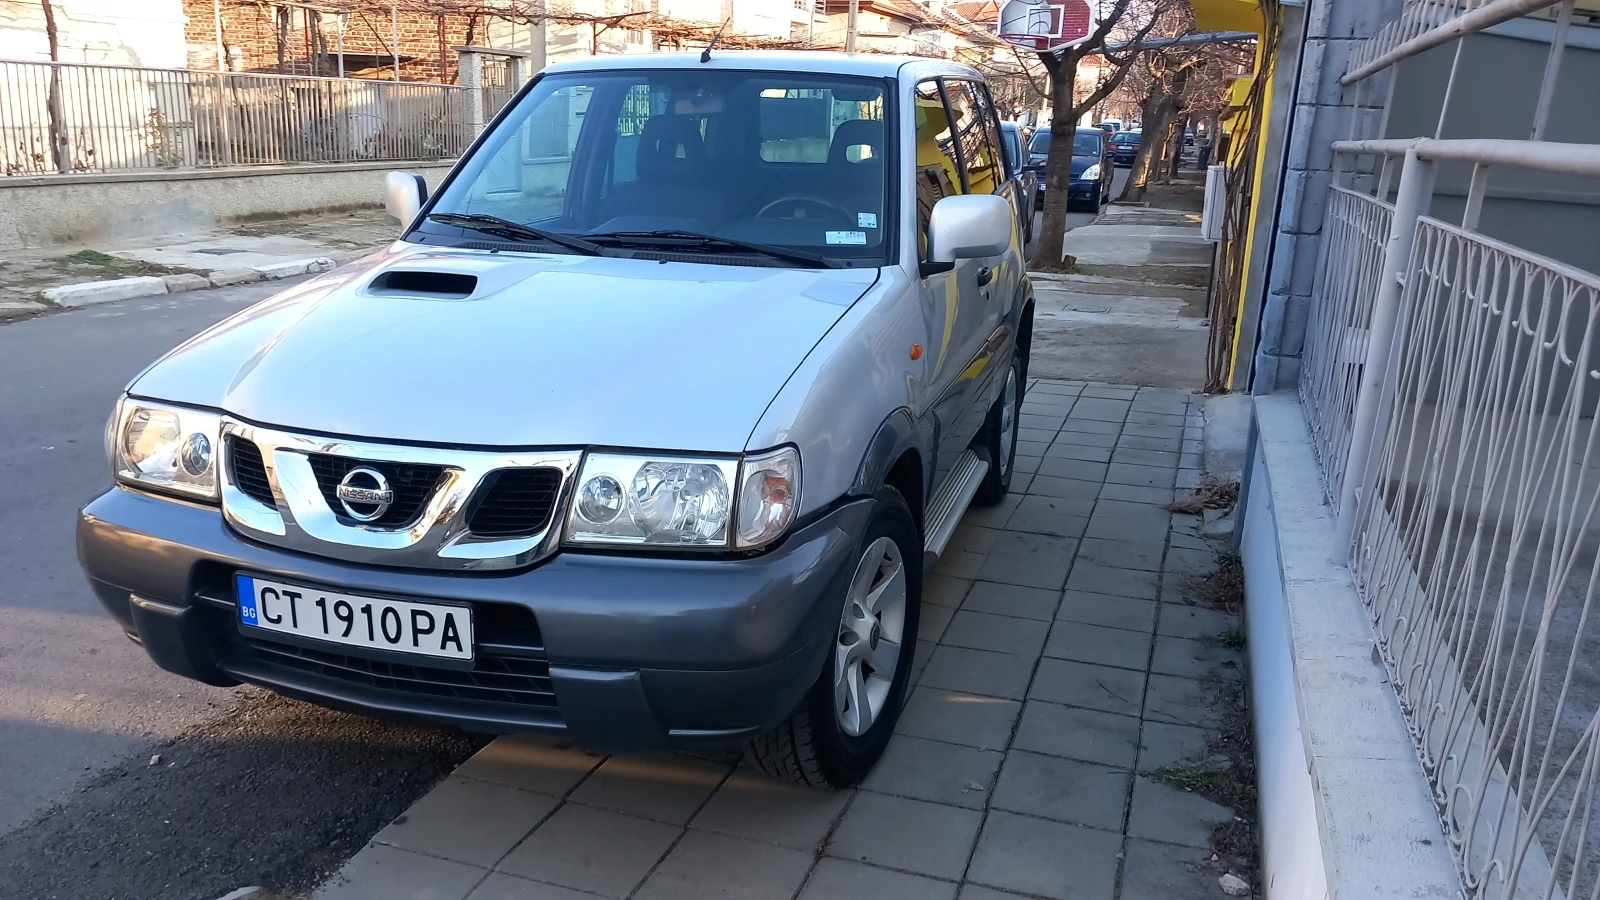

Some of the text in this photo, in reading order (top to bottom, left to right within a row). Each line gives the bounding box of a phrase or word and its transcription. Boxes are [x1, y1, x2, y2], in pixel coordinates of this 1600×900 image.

[339, 487, 385, 501] NISSAN
[242, 605, 256, 618] BG
[260, 586, 464, 652] CT 1910 PA
